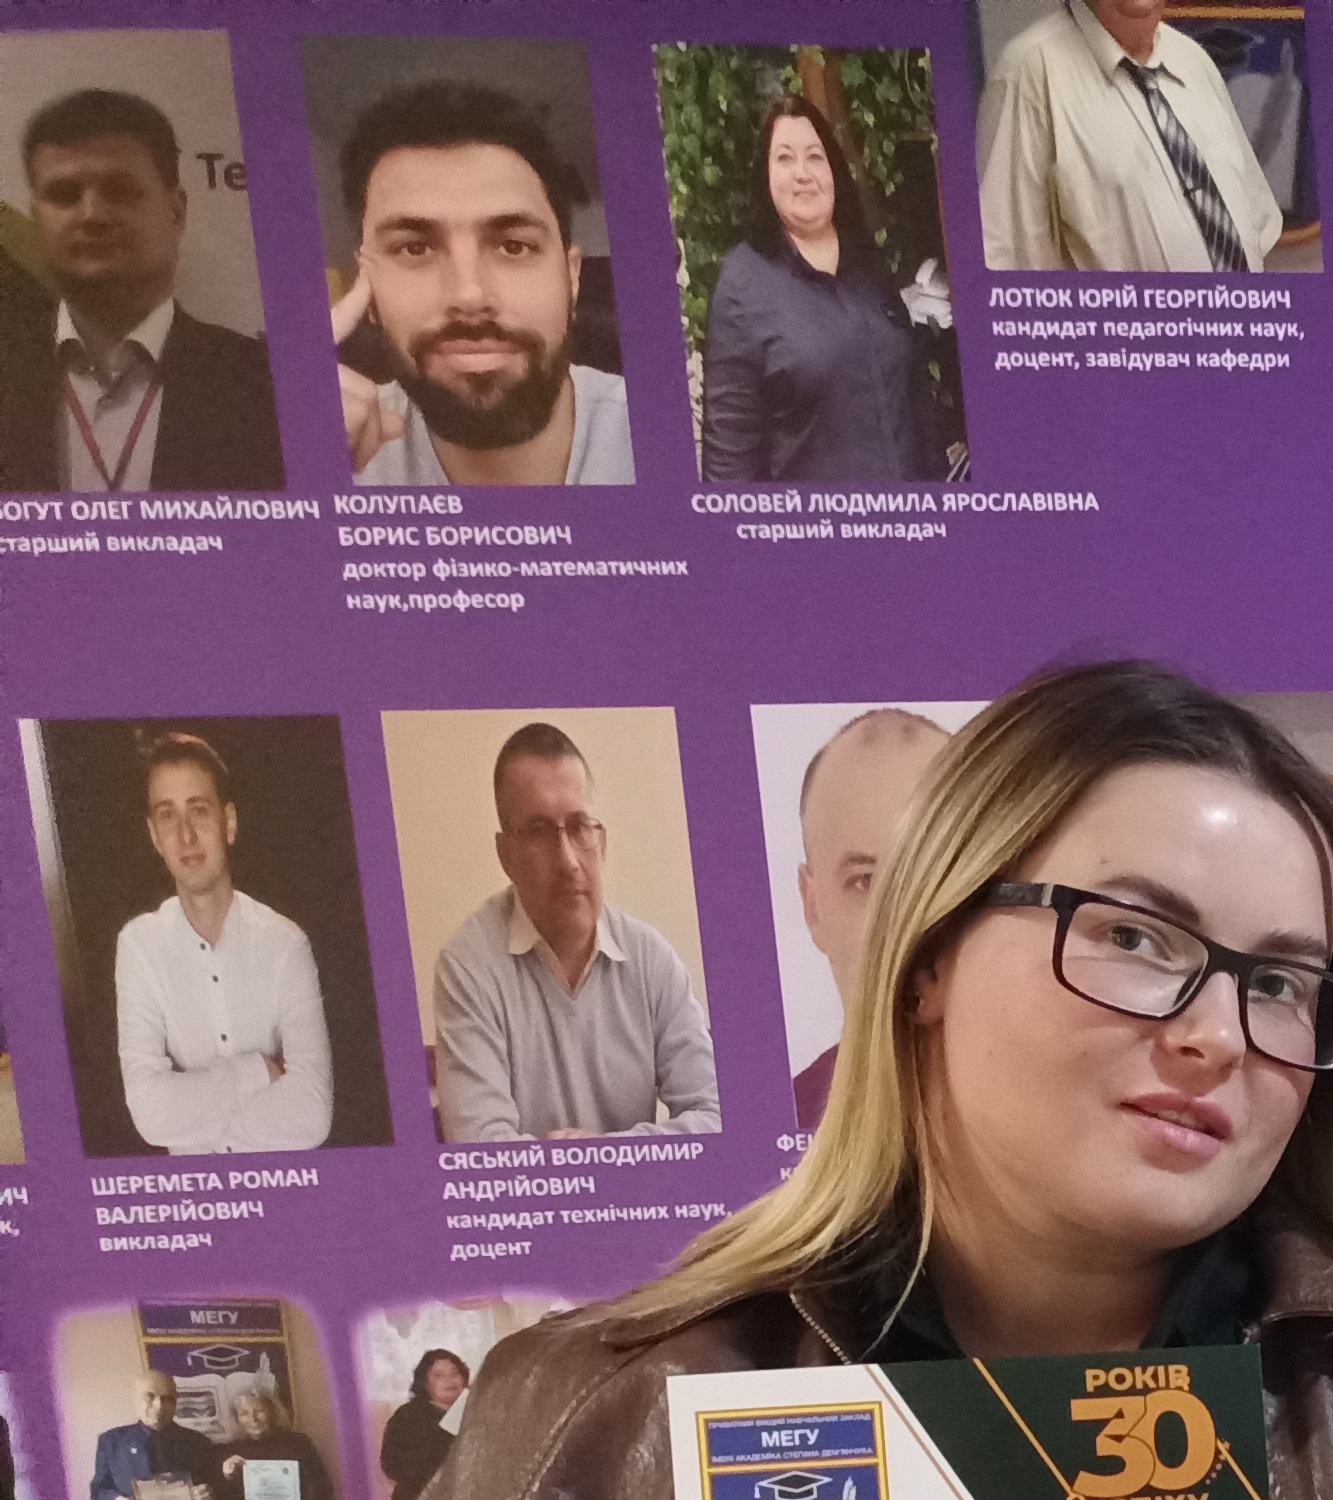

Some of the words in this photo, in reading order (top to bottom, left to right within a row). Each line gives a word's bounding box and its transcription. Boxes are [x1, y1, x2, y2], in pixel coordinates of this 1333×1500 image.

[989, 287, 1072, 307] ЛОТЮК
[1079, 285, 1137, 308] ЮРІЙ
[1144, 285, 1291, 309] ГЕОРГІЙОВИЧ
[992, 319, 1097, 339] кандидат
[1104, 318, 1244, 339] педагогічних
[1250, 321, 1305, 340] наук,
[995, 351, 1079, 370] доцент,
[1086, 348, 1190, 371] завідувач
[1197, 349, 1290, 371] кафедри
[71, 500, 134, 520] ОЛЕГ
[140, 495, 320, 520] МИХАЙЛОВИЧ
[334, 494, 463, 515] КОЛУПАЄВ
[691, 490, 802, 513] СОЛОВЕЙ
[808, 492, 937, 516] ЛЮДМИЛА
[943, 492, 1099, 513] ЯРОСЛАВІВНА
[338, 526, 420, 546] БОРИС
[426, 525, 572, 546] БОРИСОВИЧ
[736, 519, 834, 543] старший
[841, 522, 946, 541] викладач
[107, 534, 223, 554] викладач
[343, 561, 427, 581] доктор
[432, 558, 688, 581] фізико-математичних
[439, 1145, 545, 1171] СЯСЬКИЙ
[551, 1143, 703, 1167] ВОЛОДИМИР
[92, 1172, 223, 1196] ШЕРЕМЕТА
[229, 1168, 319, 1190] РОМАН
[443, 1175, 595, 1202] АНДРІЙОВИЧ
[96, 1199, 264, 1225] ВАЛЕРІЙОВИЧ
[447, 1211, 554, 1231] кандидат
[561, 1203, 669, 1224] технічних
[100, 1232, 212, 1252] викладач
[450, 1240, 532, 1261] доцент
[1086, 1365, 1190, 1394] РОКІВ
[761, 1429, 819, 1447] МЕГУ
[1070, 1388, 1216, 1498] 30
